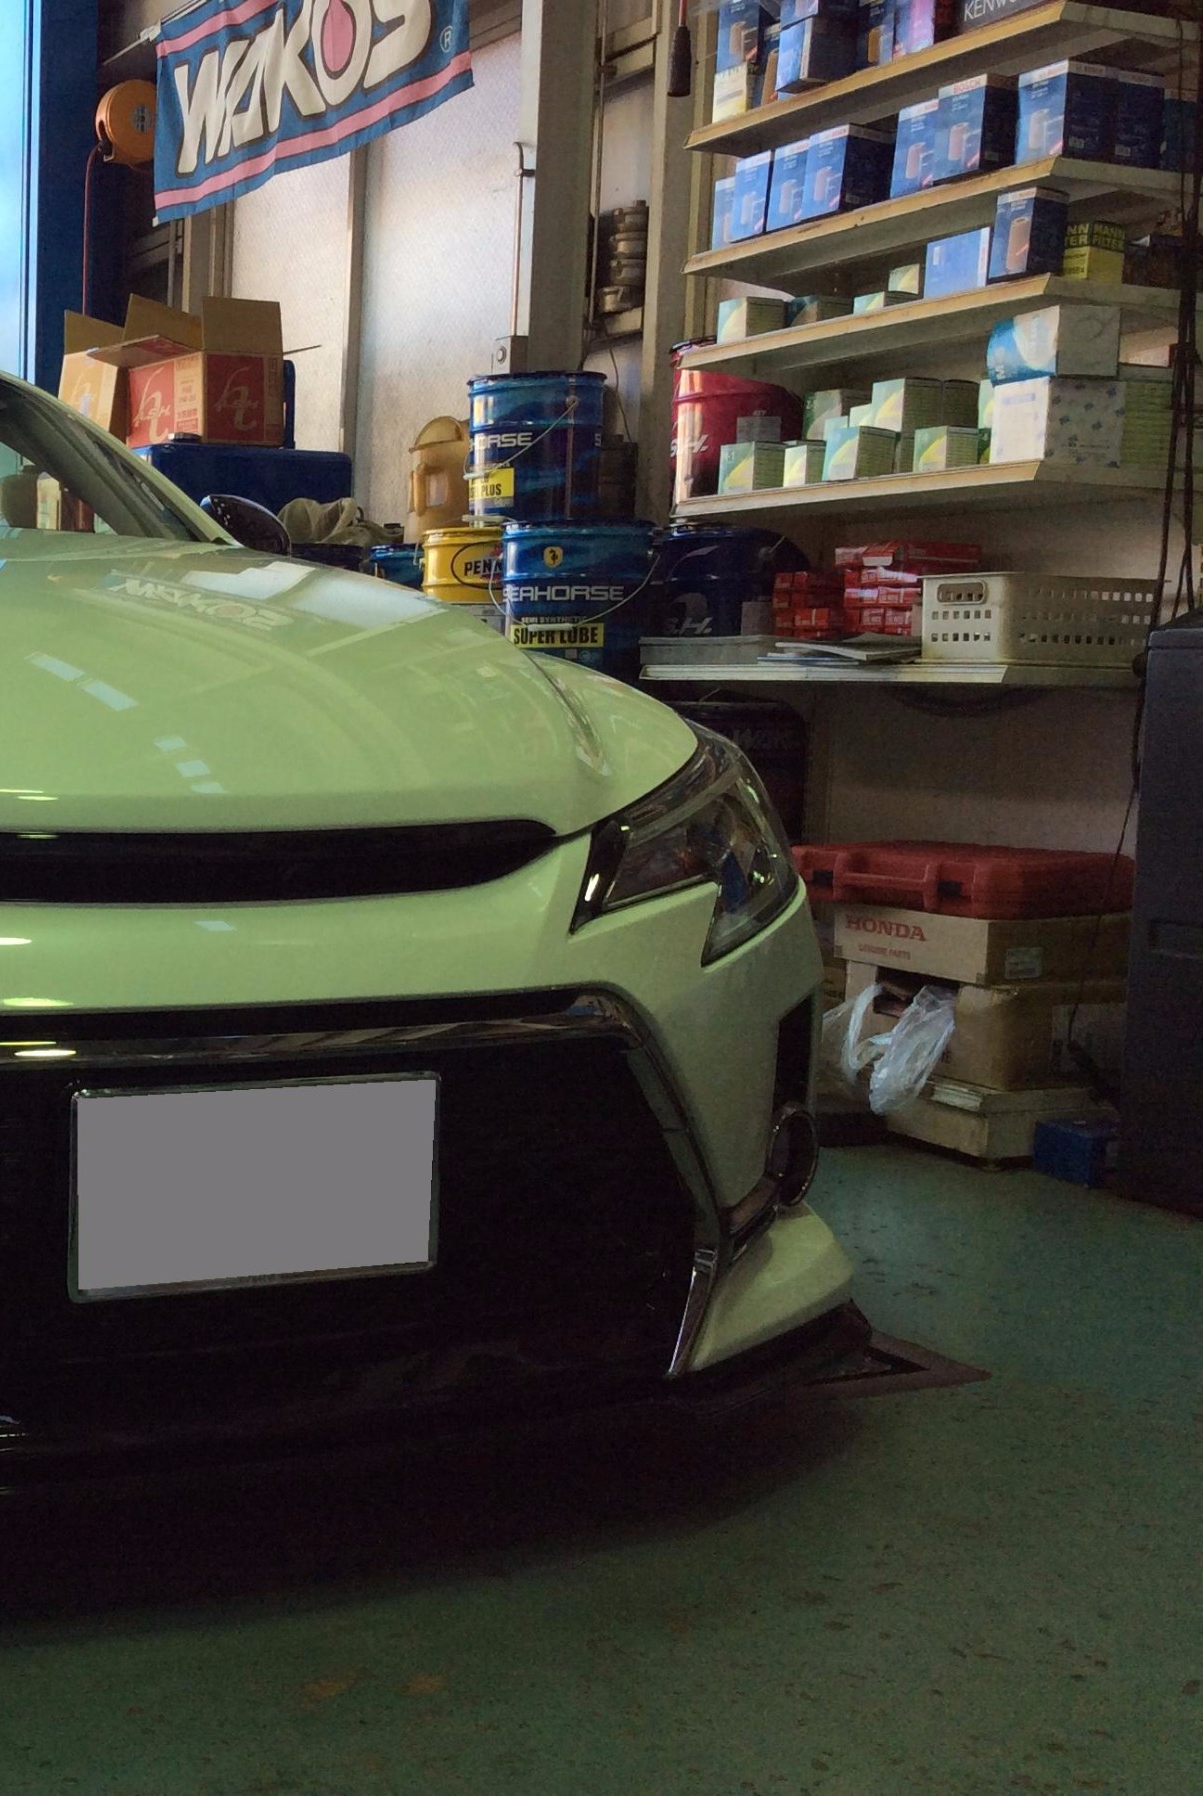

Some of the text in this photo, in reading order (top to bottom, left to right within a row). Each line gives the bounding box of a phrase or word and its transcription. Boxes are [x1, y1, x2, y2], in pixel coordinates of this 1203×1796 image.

[513, 626, 598, 645] SUPER LUBE
[845, 914, 927, 942] HONDA
